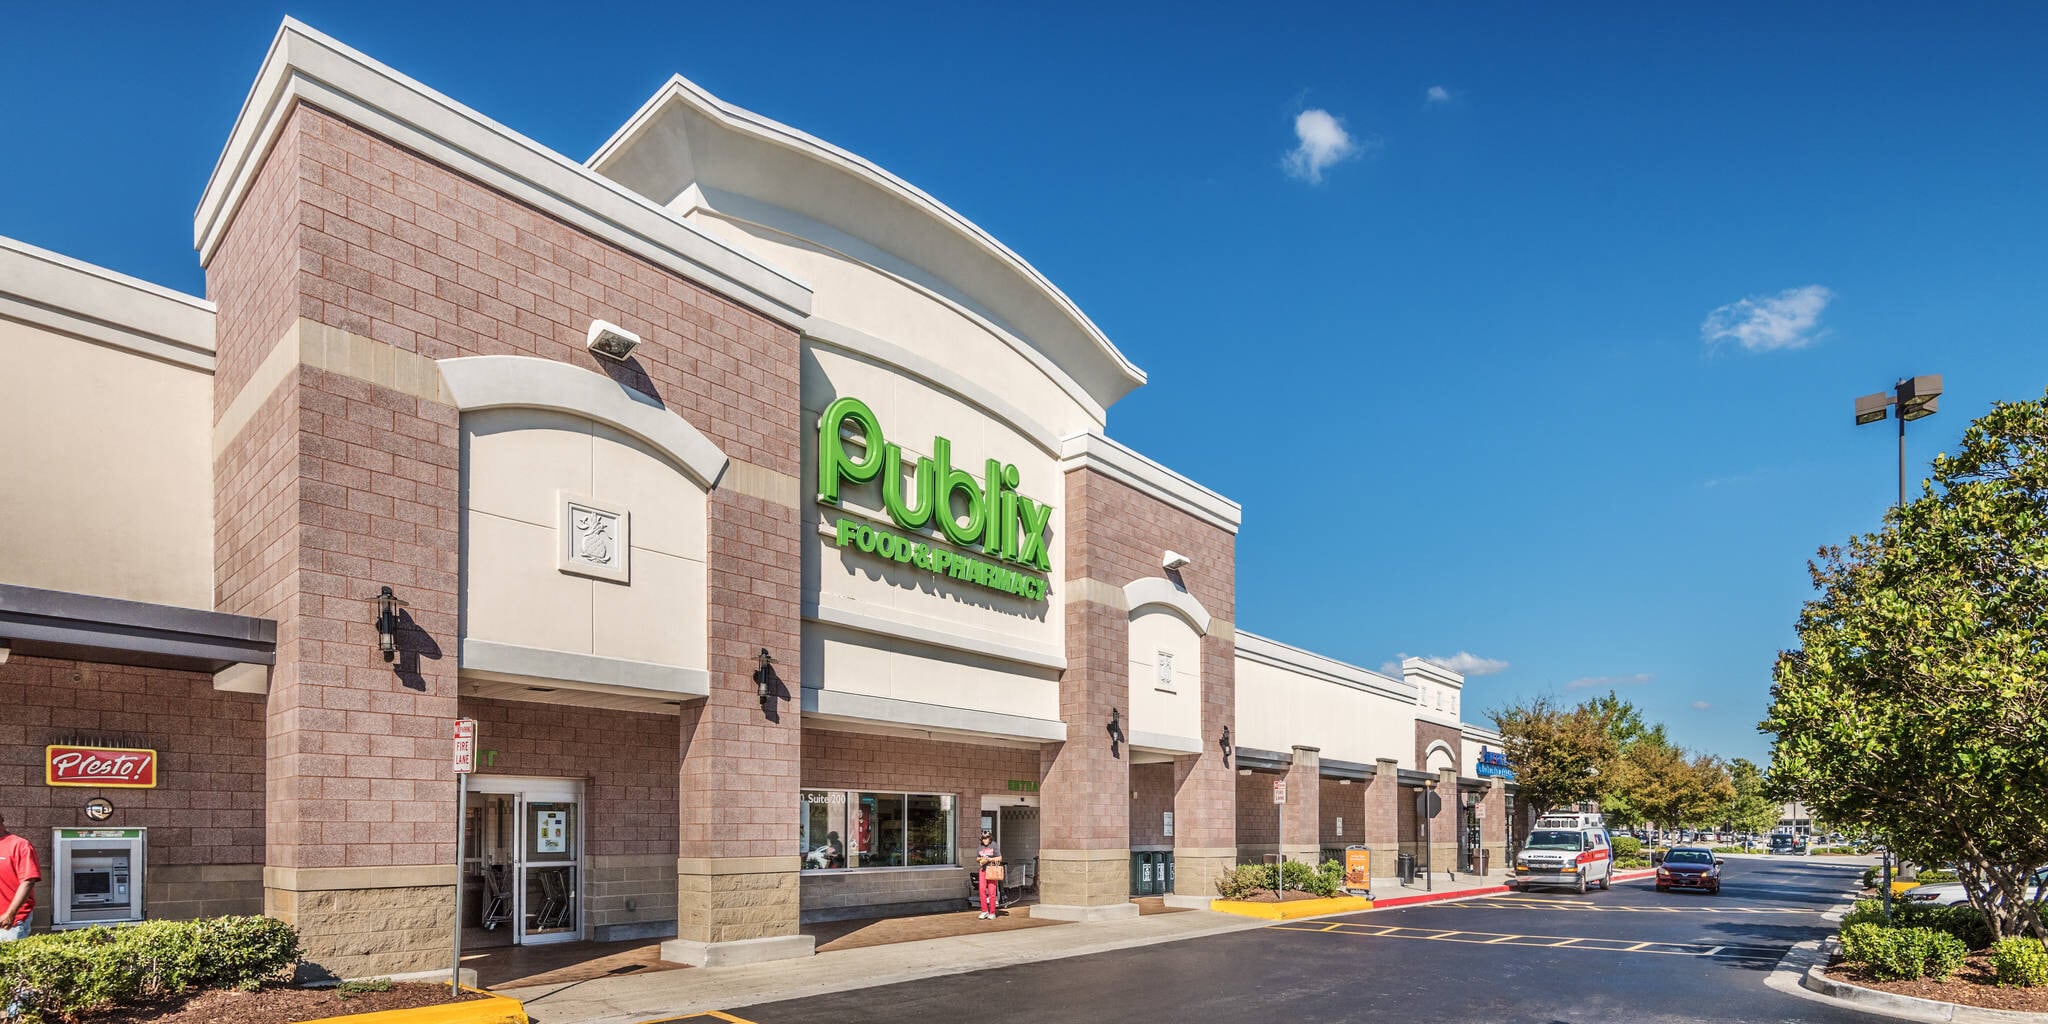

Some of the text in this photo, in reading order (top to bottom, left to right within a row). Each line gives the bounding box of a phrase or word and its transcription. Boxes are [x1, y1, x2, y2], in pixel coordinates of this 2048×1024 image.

[818, 397, 1053, 572] Publix
[457, 741, 469, 751] FIRE
[456, 755, 469, 765] LANE
[52, 752, 152, 780] Presto!
[1008, 780, 1039, 792] ENTRA
[808, 793, 829, 803] Suite
[831, 794, 846, 804] 200
